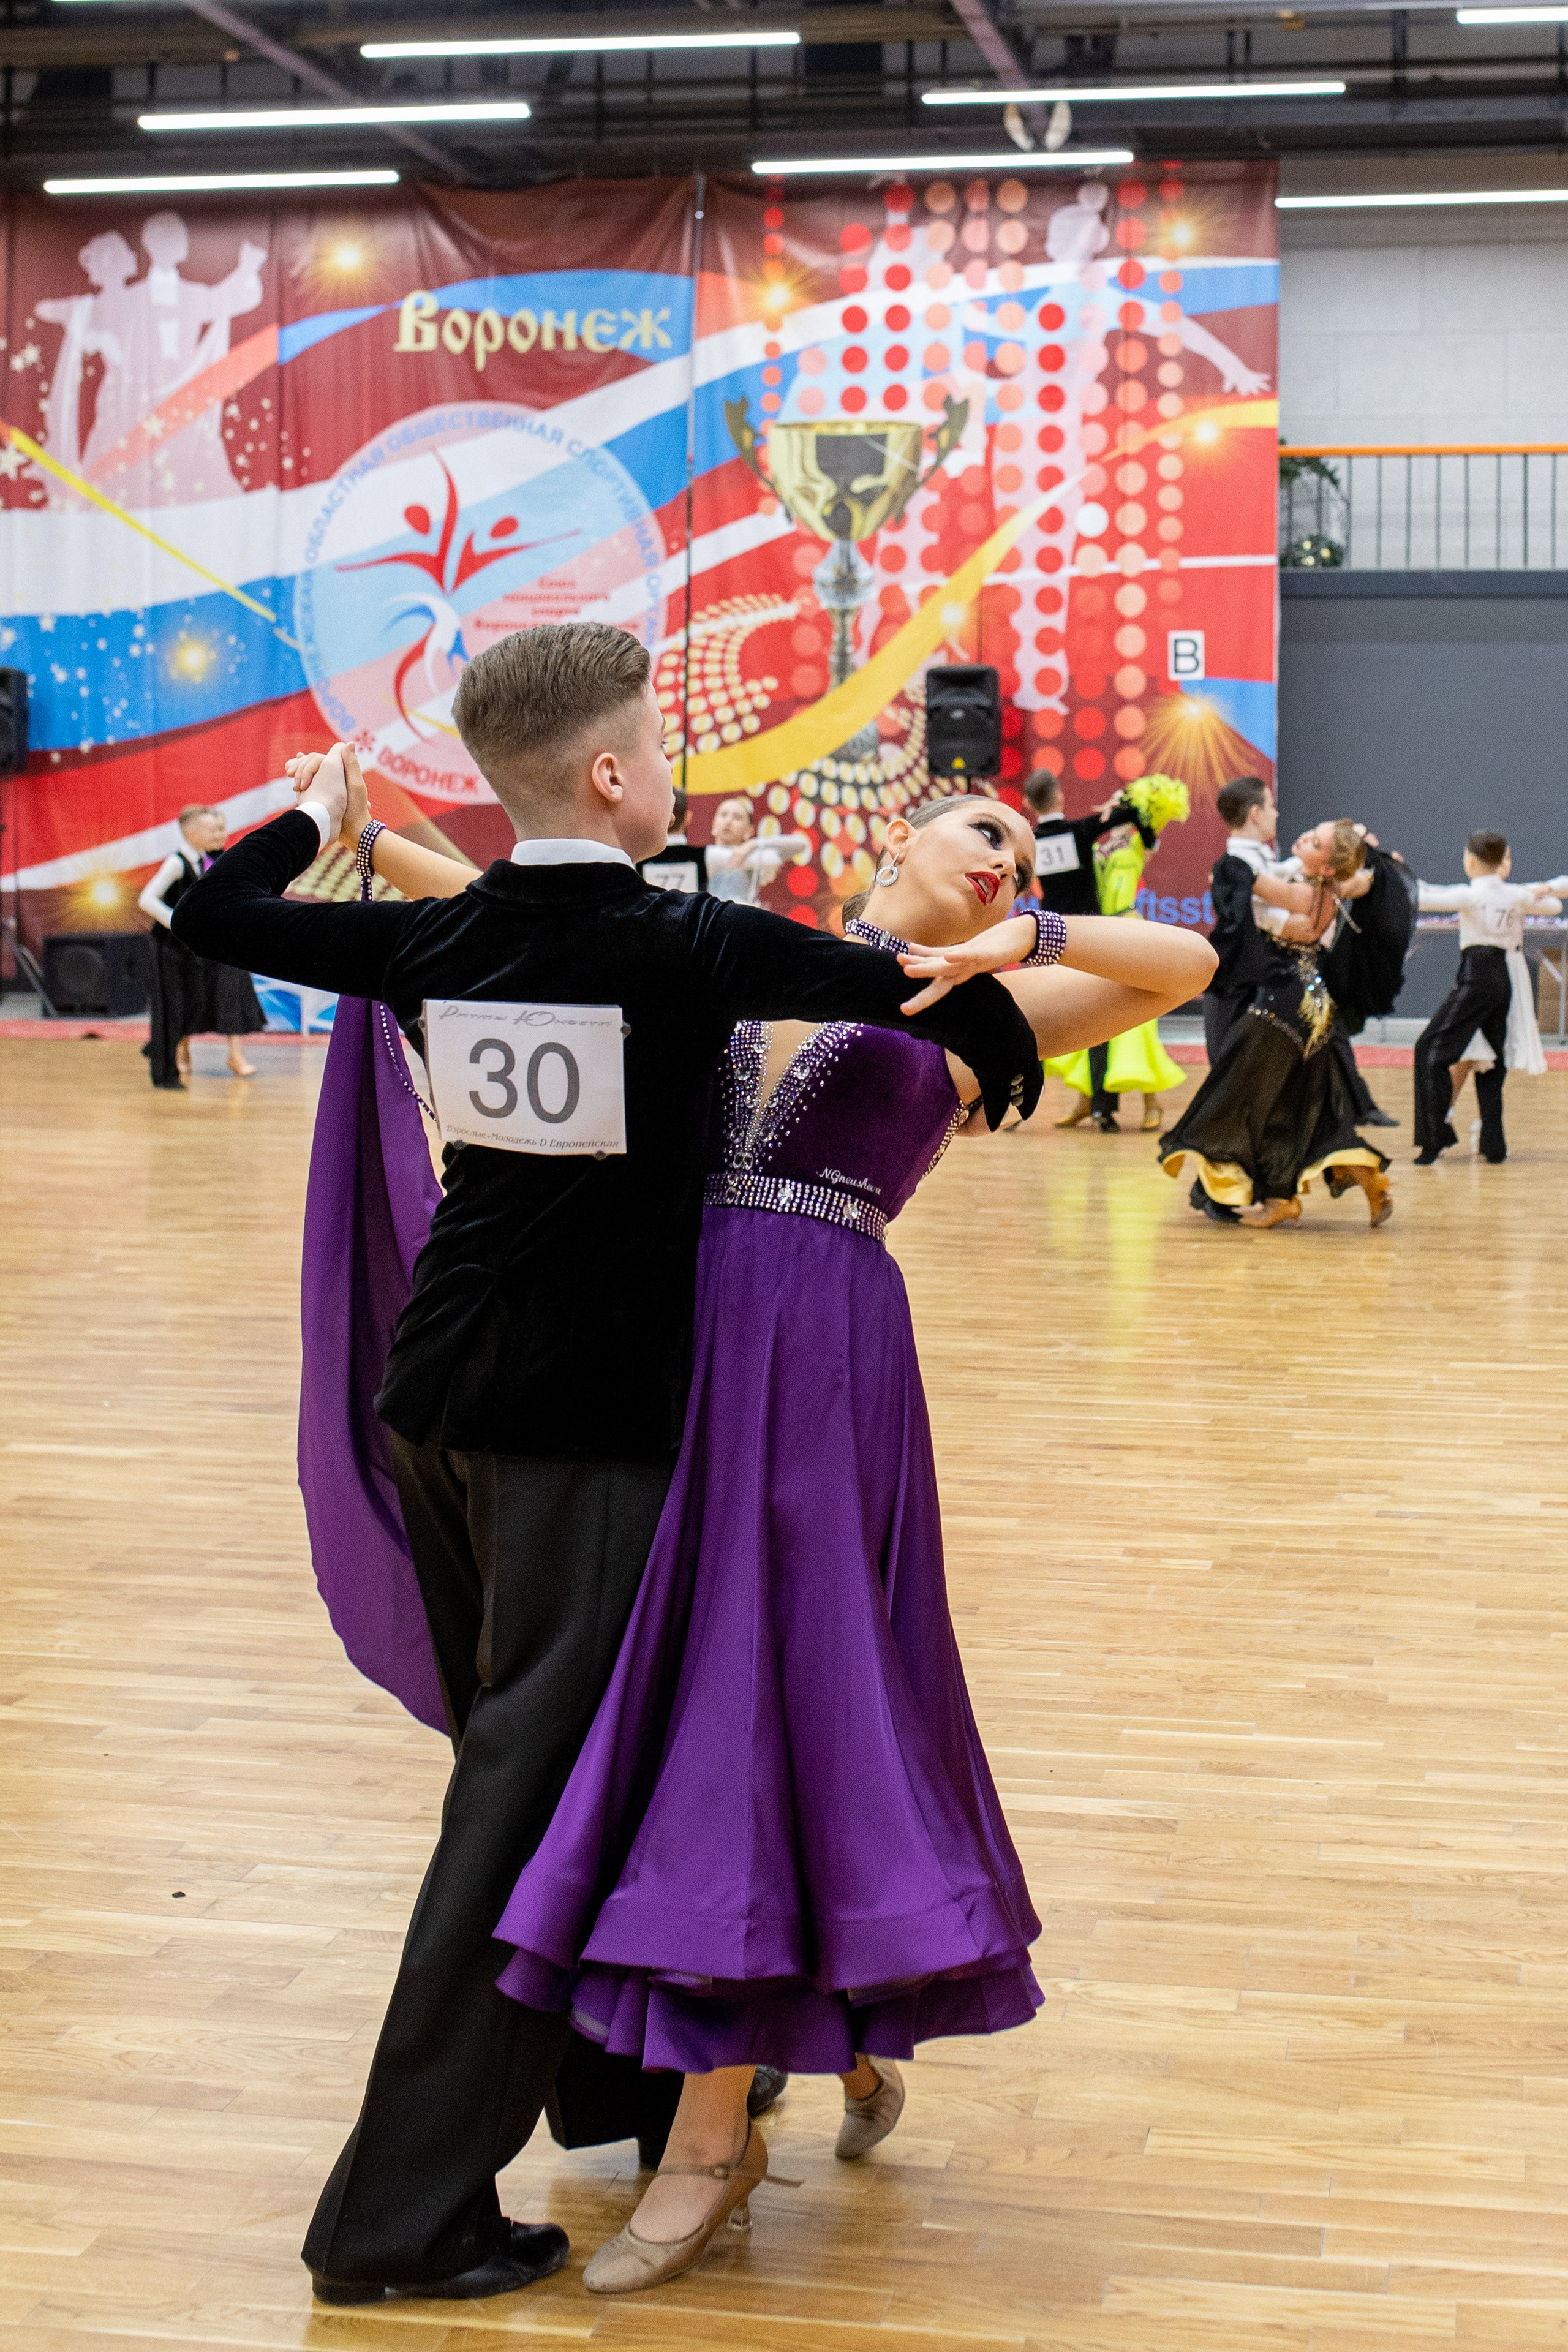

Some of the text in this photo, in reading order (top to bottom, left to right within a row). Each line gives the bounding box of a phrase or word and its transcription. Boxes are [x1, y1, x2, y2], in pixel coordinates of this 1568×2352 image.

[393, 290, 671, 372] Воронеж
[377, 746, 478, 794] ВОРОНЕЖ
[1040, 846, 1066, 867] 31
[469, 1038, 581, 1124] 30
